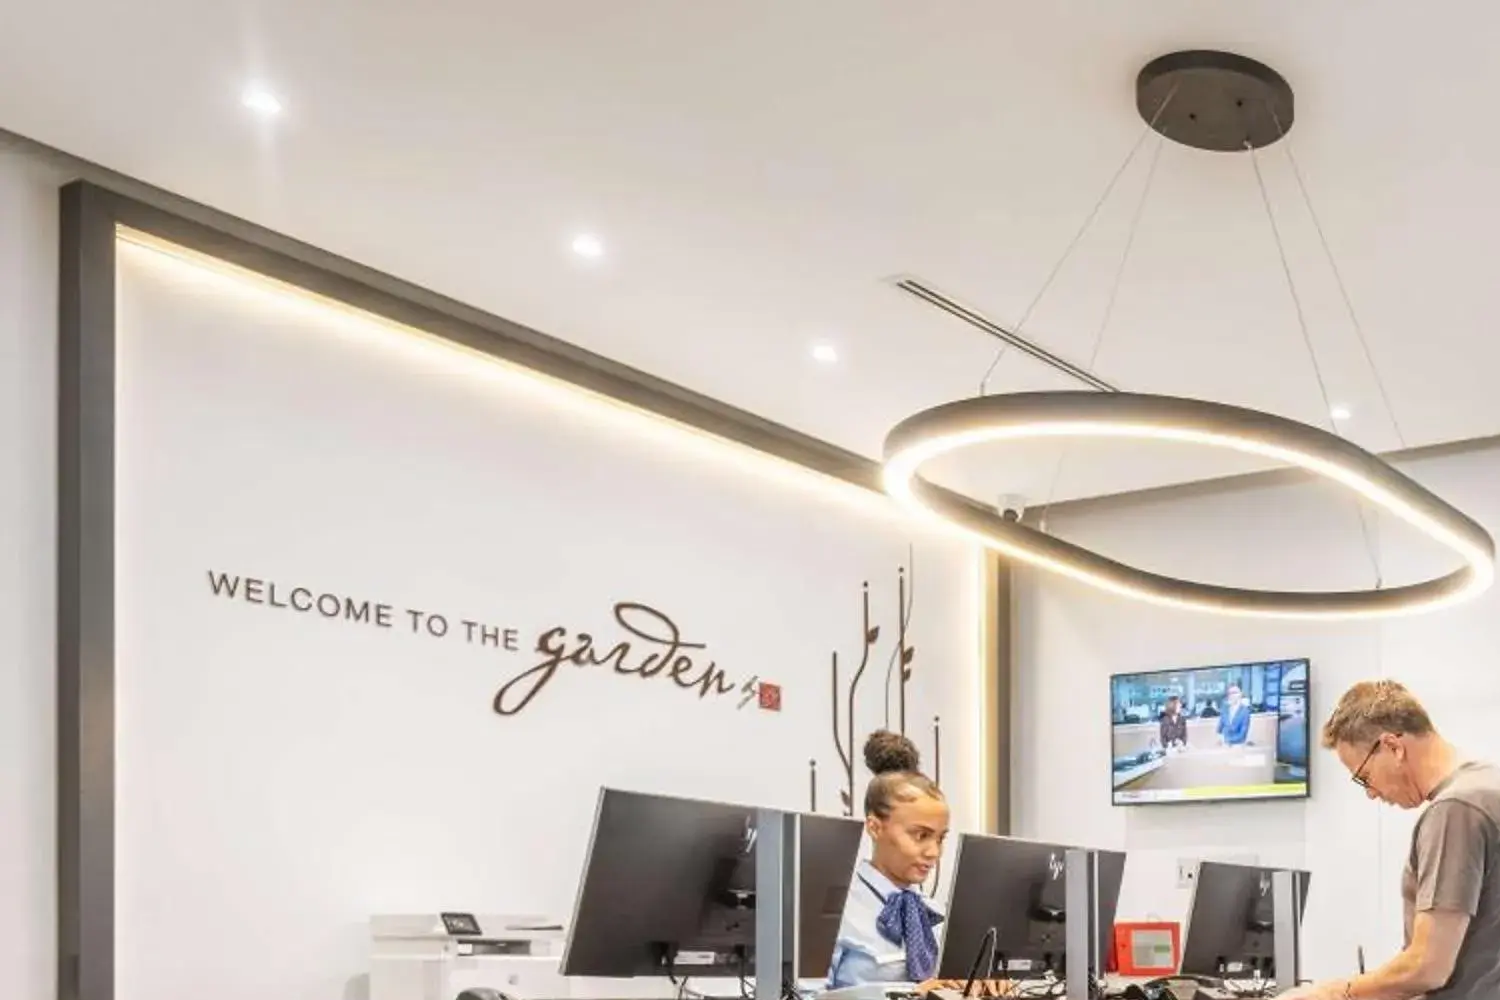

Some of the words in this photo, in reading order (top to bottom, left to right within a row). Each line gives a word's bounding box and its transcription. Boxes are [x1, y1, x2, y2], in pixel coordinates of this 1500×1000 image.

[206, 570, 394, 628] WELCOME
[406, 609, 449, 637] TO
[461, 620, 519, 652] THE
[492, 601, 736, 716] garden
